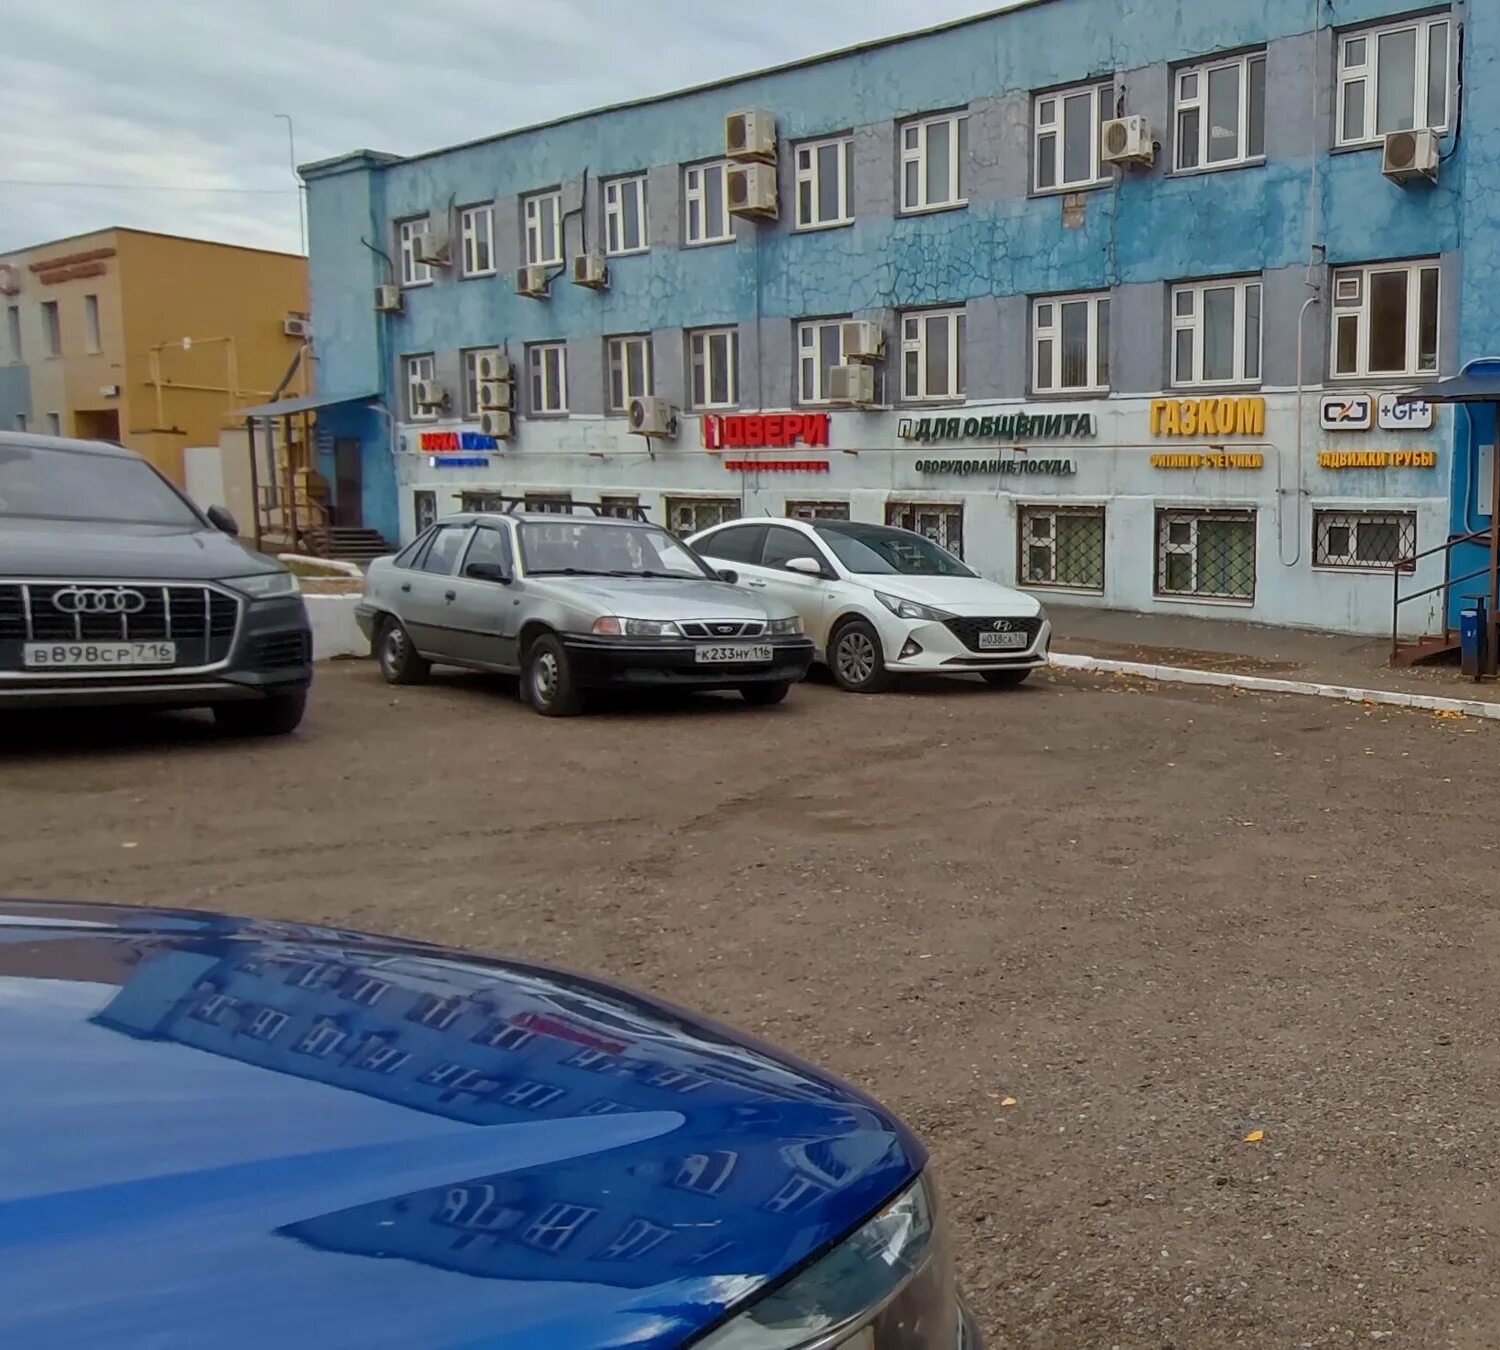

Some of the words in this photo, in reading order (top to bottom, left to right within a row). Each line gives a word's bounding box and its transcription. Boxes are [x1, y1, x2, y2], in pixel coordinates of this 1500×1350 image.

[723, 412, 831, 448] ДВЕРИ
[914, 417, 961, 441] ДЛЯ
[963, 413, 1093, 439] ОБЩЕПИТА
[1150, 397, 1264, 436] ГАЗКОМ
[33, 646, 130, 663] В898СР
[132, 644, 171, 657] 716
[702, 648, 749, 660] К233НУ
[754, 646, 770, 657] 116
